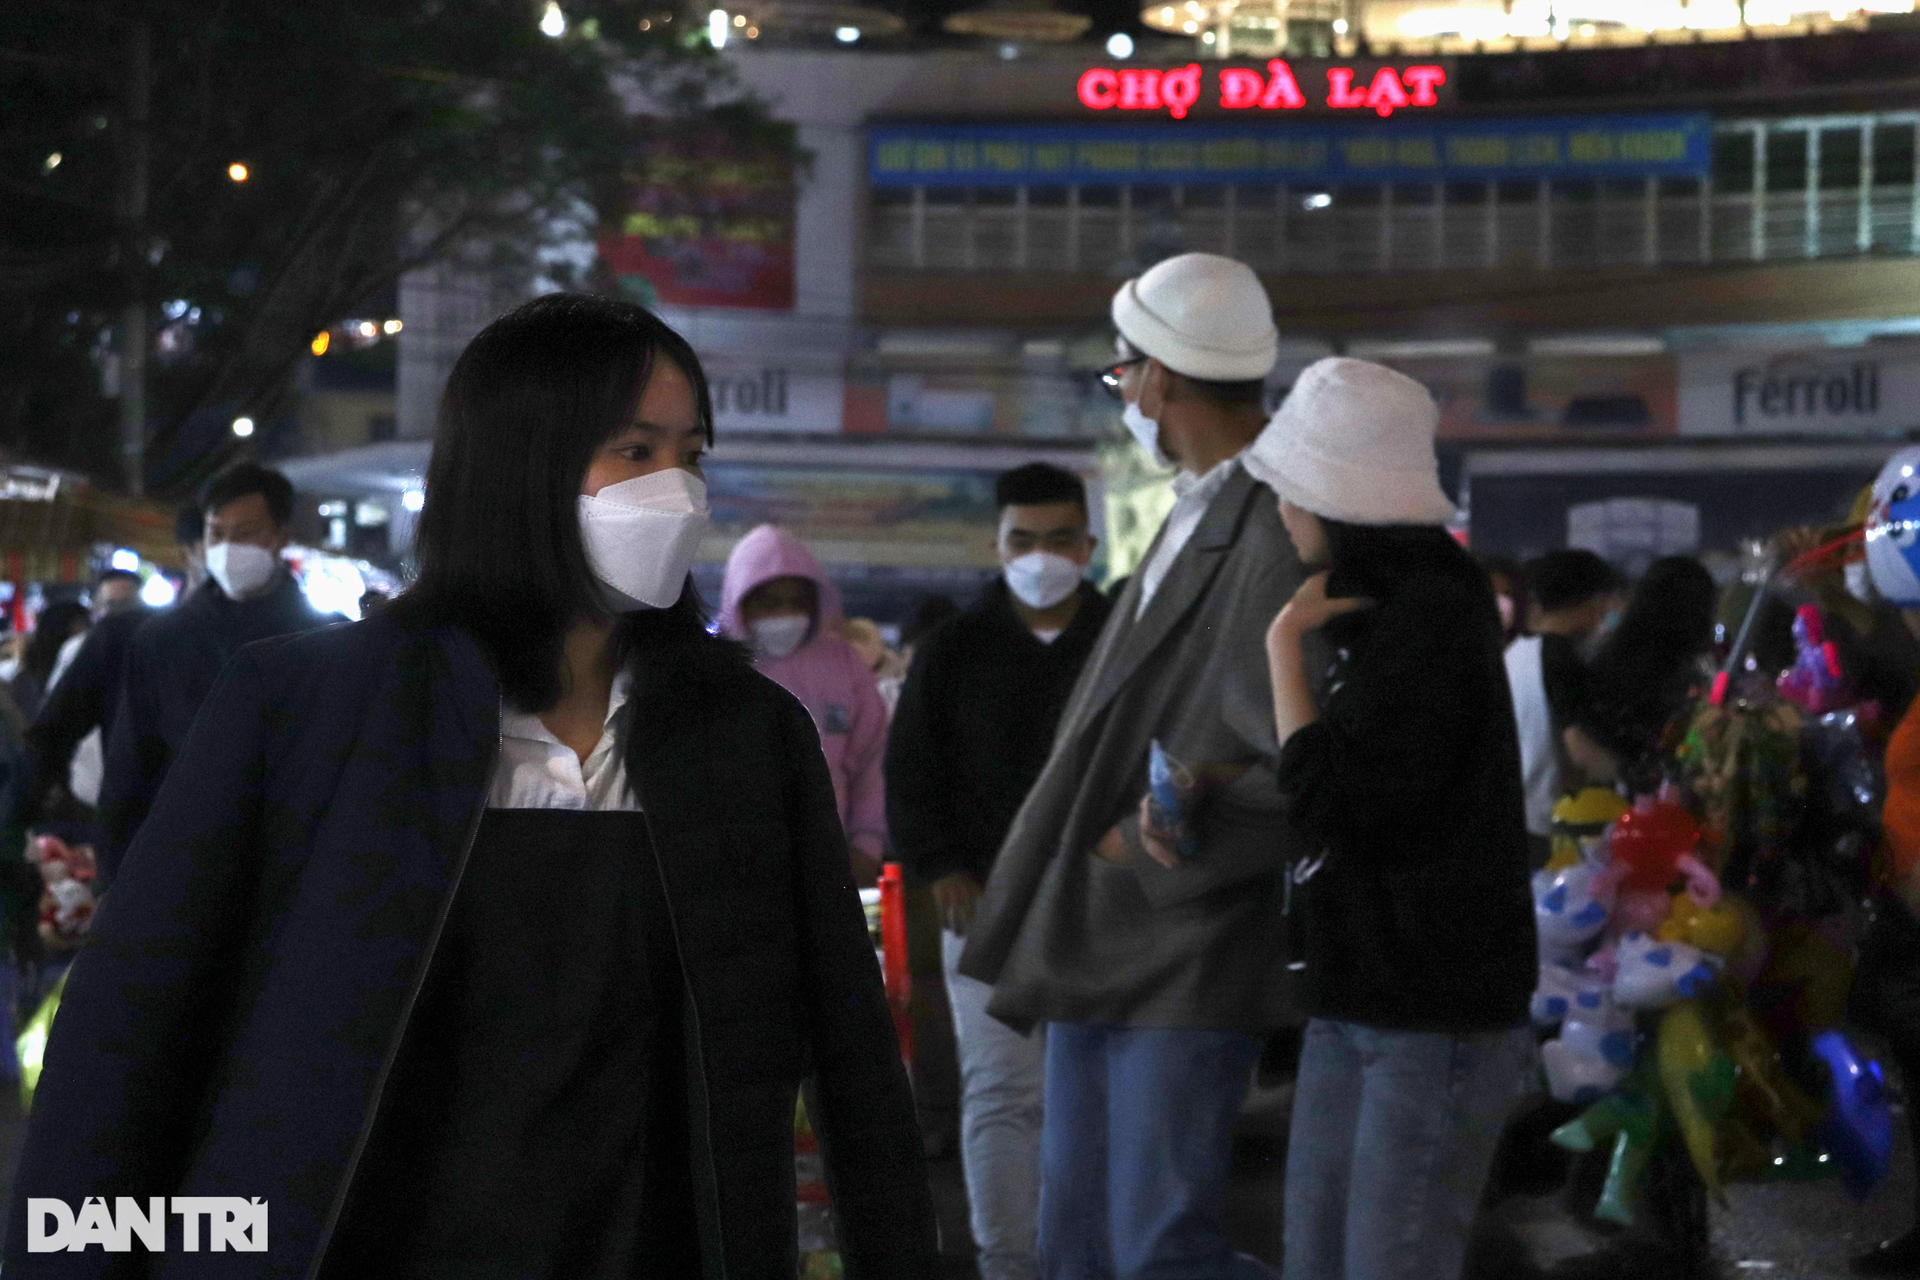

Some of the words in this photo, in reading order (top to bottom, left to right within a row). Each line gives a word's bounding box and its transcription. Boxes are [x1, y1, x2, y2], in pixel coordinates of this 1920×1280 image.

[1077, 63, 1202, 118] CHỢ
[1219, 58, 1306, 108] ĐÀ
[1326, 65, 1446, 117] LẠT
